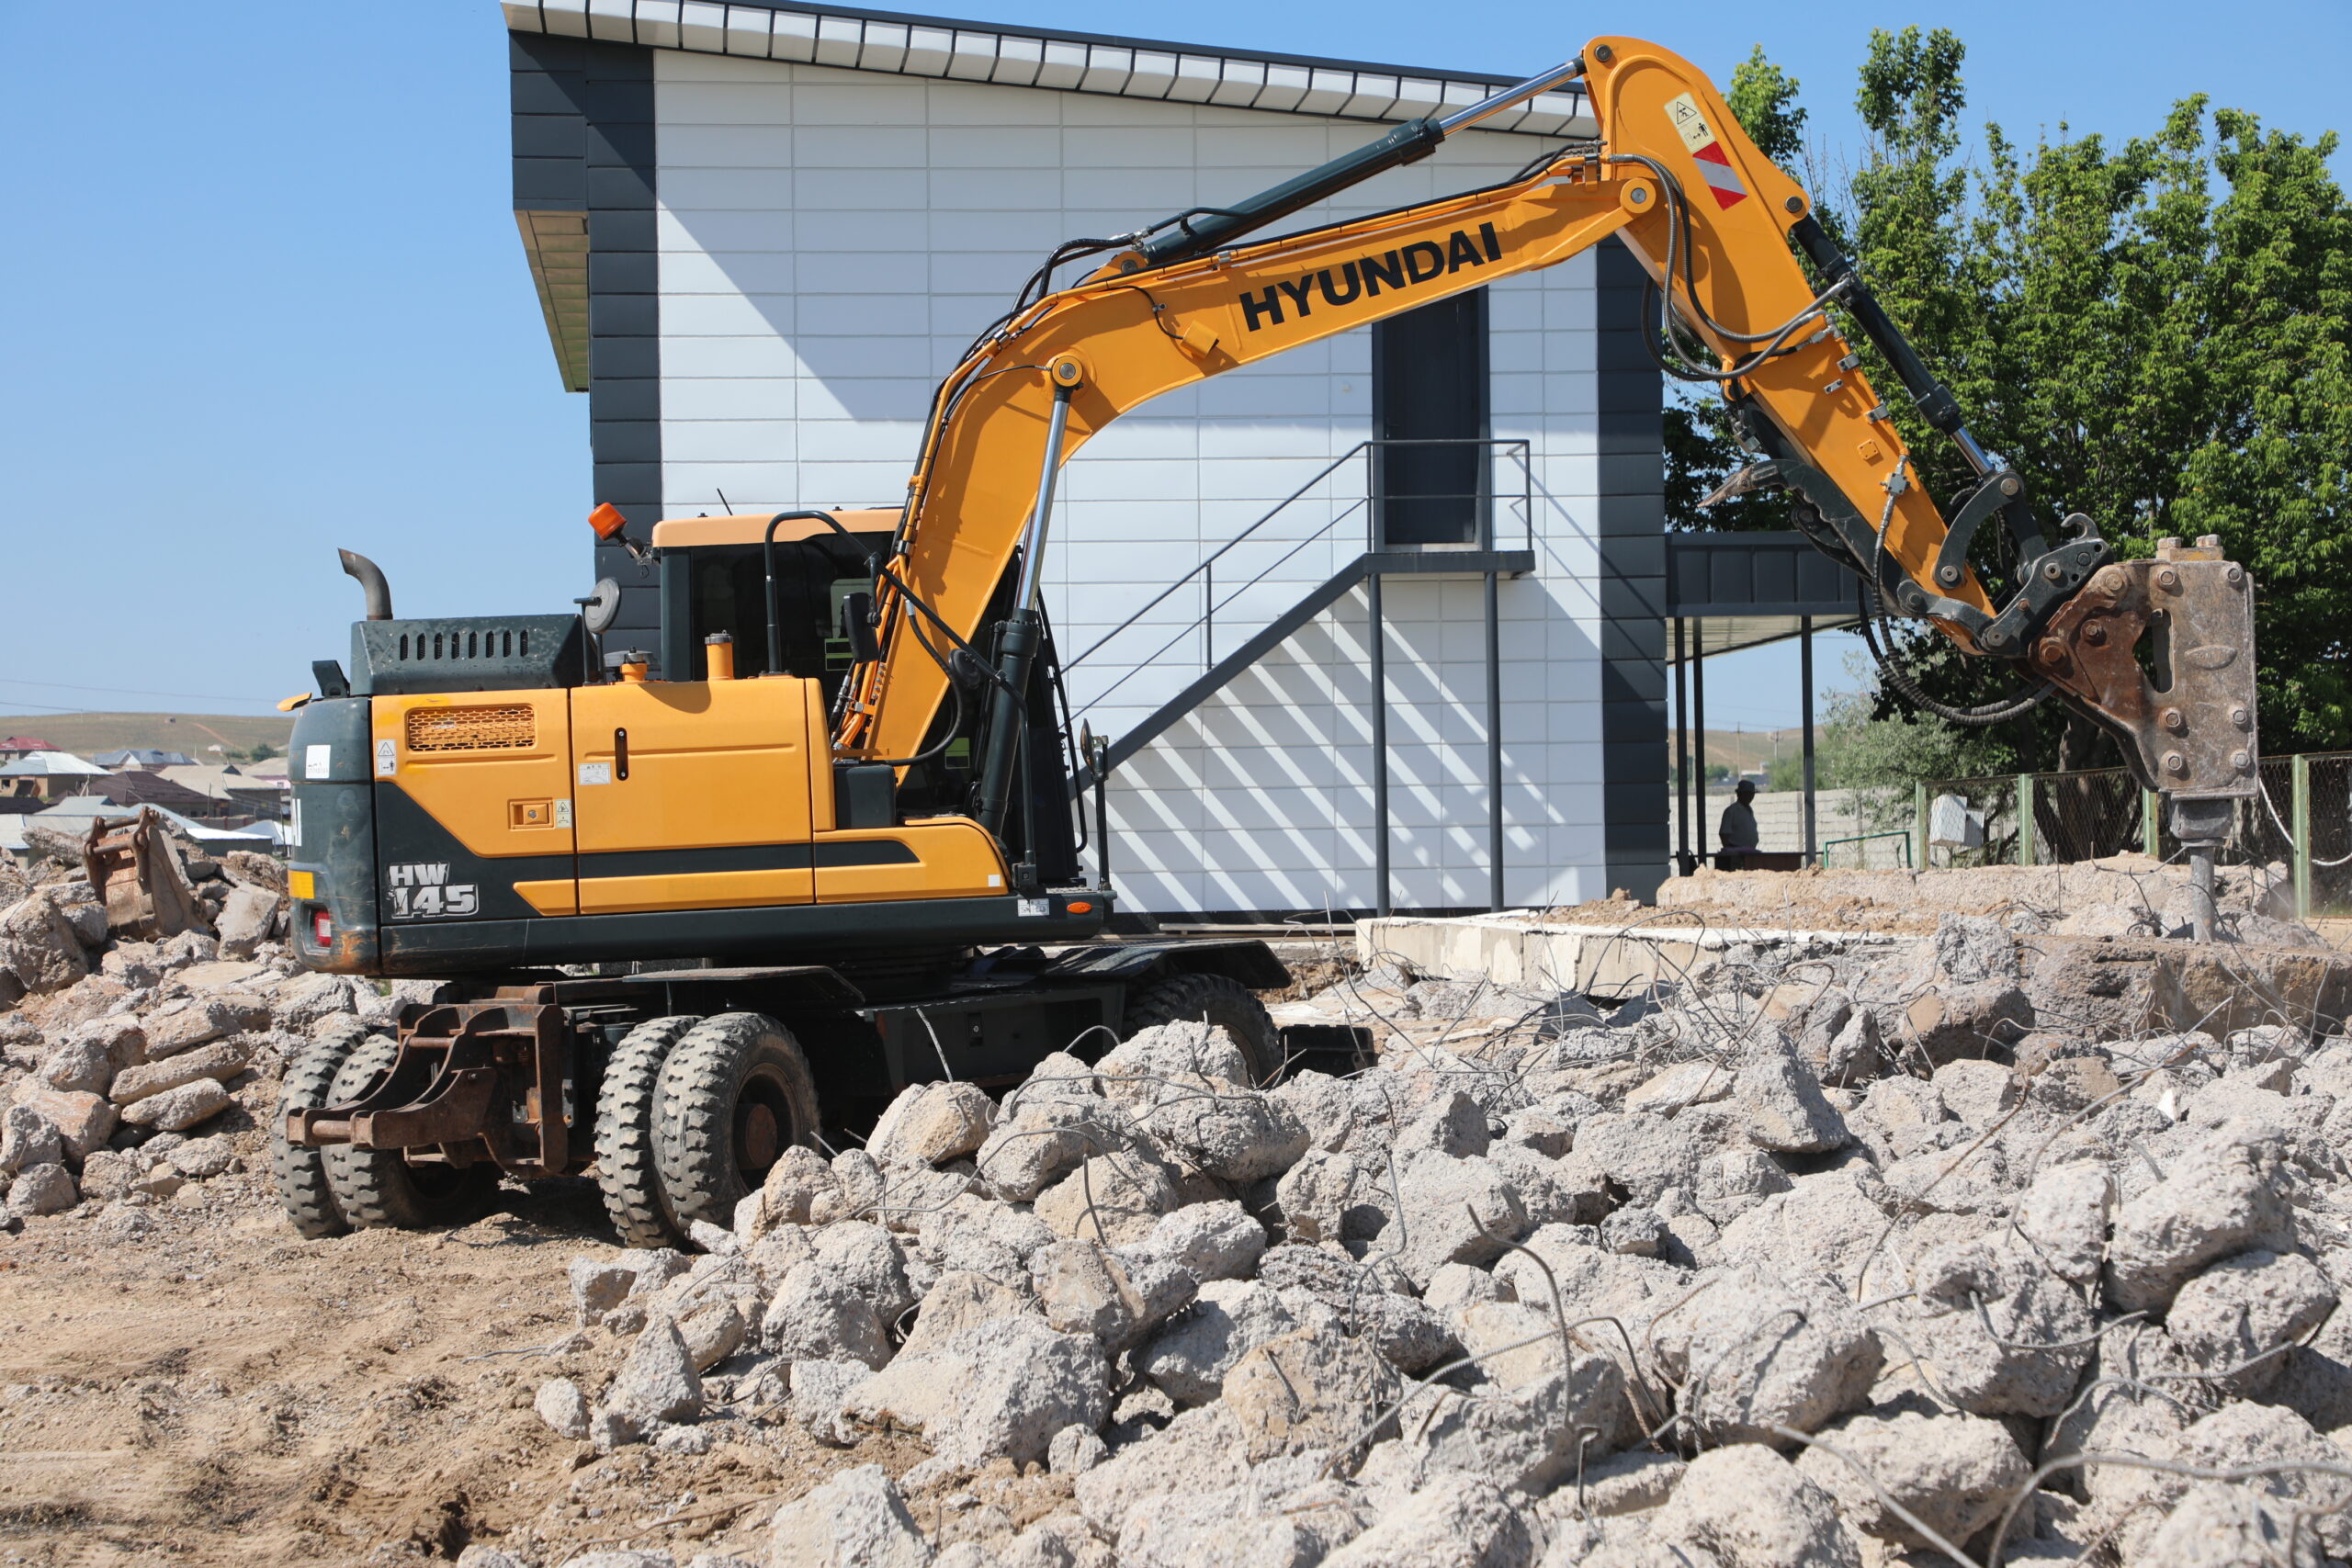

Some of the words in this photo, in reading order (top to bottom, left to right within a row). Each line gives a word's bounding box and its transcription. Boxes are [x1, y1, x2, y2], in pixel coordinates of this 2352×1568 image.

[1239, 221, 1502, 333] HYUNDAI
[389, 863, 449, 886] HW
[391, 885, 477, 916] 145
